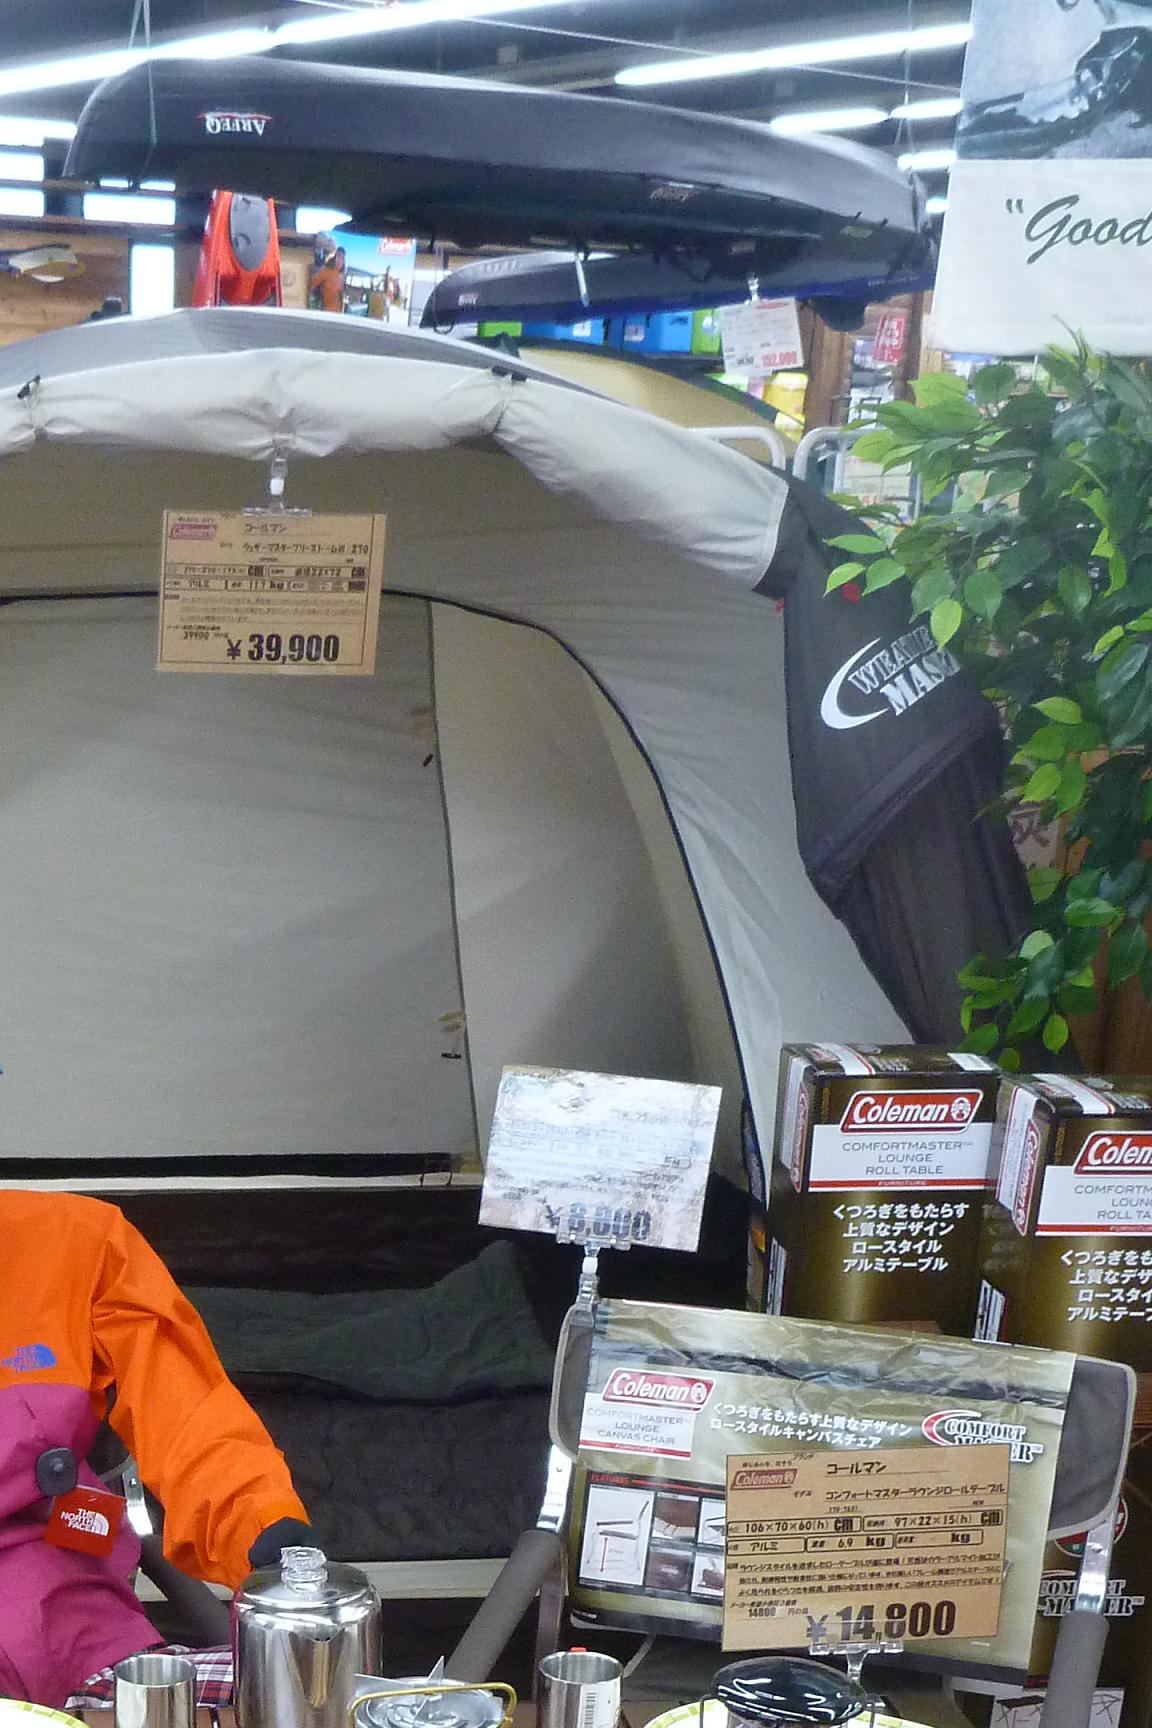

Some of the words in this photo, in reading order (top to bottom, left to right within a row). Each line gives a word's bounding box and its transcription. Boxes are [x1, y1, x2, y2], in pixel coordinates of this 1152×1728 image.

[854, 1096, 948, 1124] Coleman
[878, 1153, 934, 1163] LOUNGE
[866, 1165, 899, 1175] ROLL
[903, 1164, 944, 1174] TABLE
[833, 1202, 970, 1220] くつろぎをもたらす
[1097, 1210, 1133, 1220] ROLL
[842, 1221, 955, 1238] 上質なデザイン
[851, 1239, 943, 1255] ロースタイル
[842, 1256, 949, 1273] アルミテーブル
[612, 1372, 691, 1401] Coleman
[615, 1421, 660, 1433] LOUNGE
[712, 1402, 914, 1437] くつろぎをもたらす上質なデザイン
[598, 1429, 641, 1441] CANVAS
[643, 1434, 676, 1446] CHAIR
[710, 1418, 882, 1449] ロースタイルキャンバスチェア
[945, 1418, 1026, 1441] COMFORT
[826, 1461, 887, 1475] コールマン
[60, 1511, 95, 1525] NORTH
[750, 1541, 779, 1551] アルミ
[865, 1535, 886, 1547] kg
